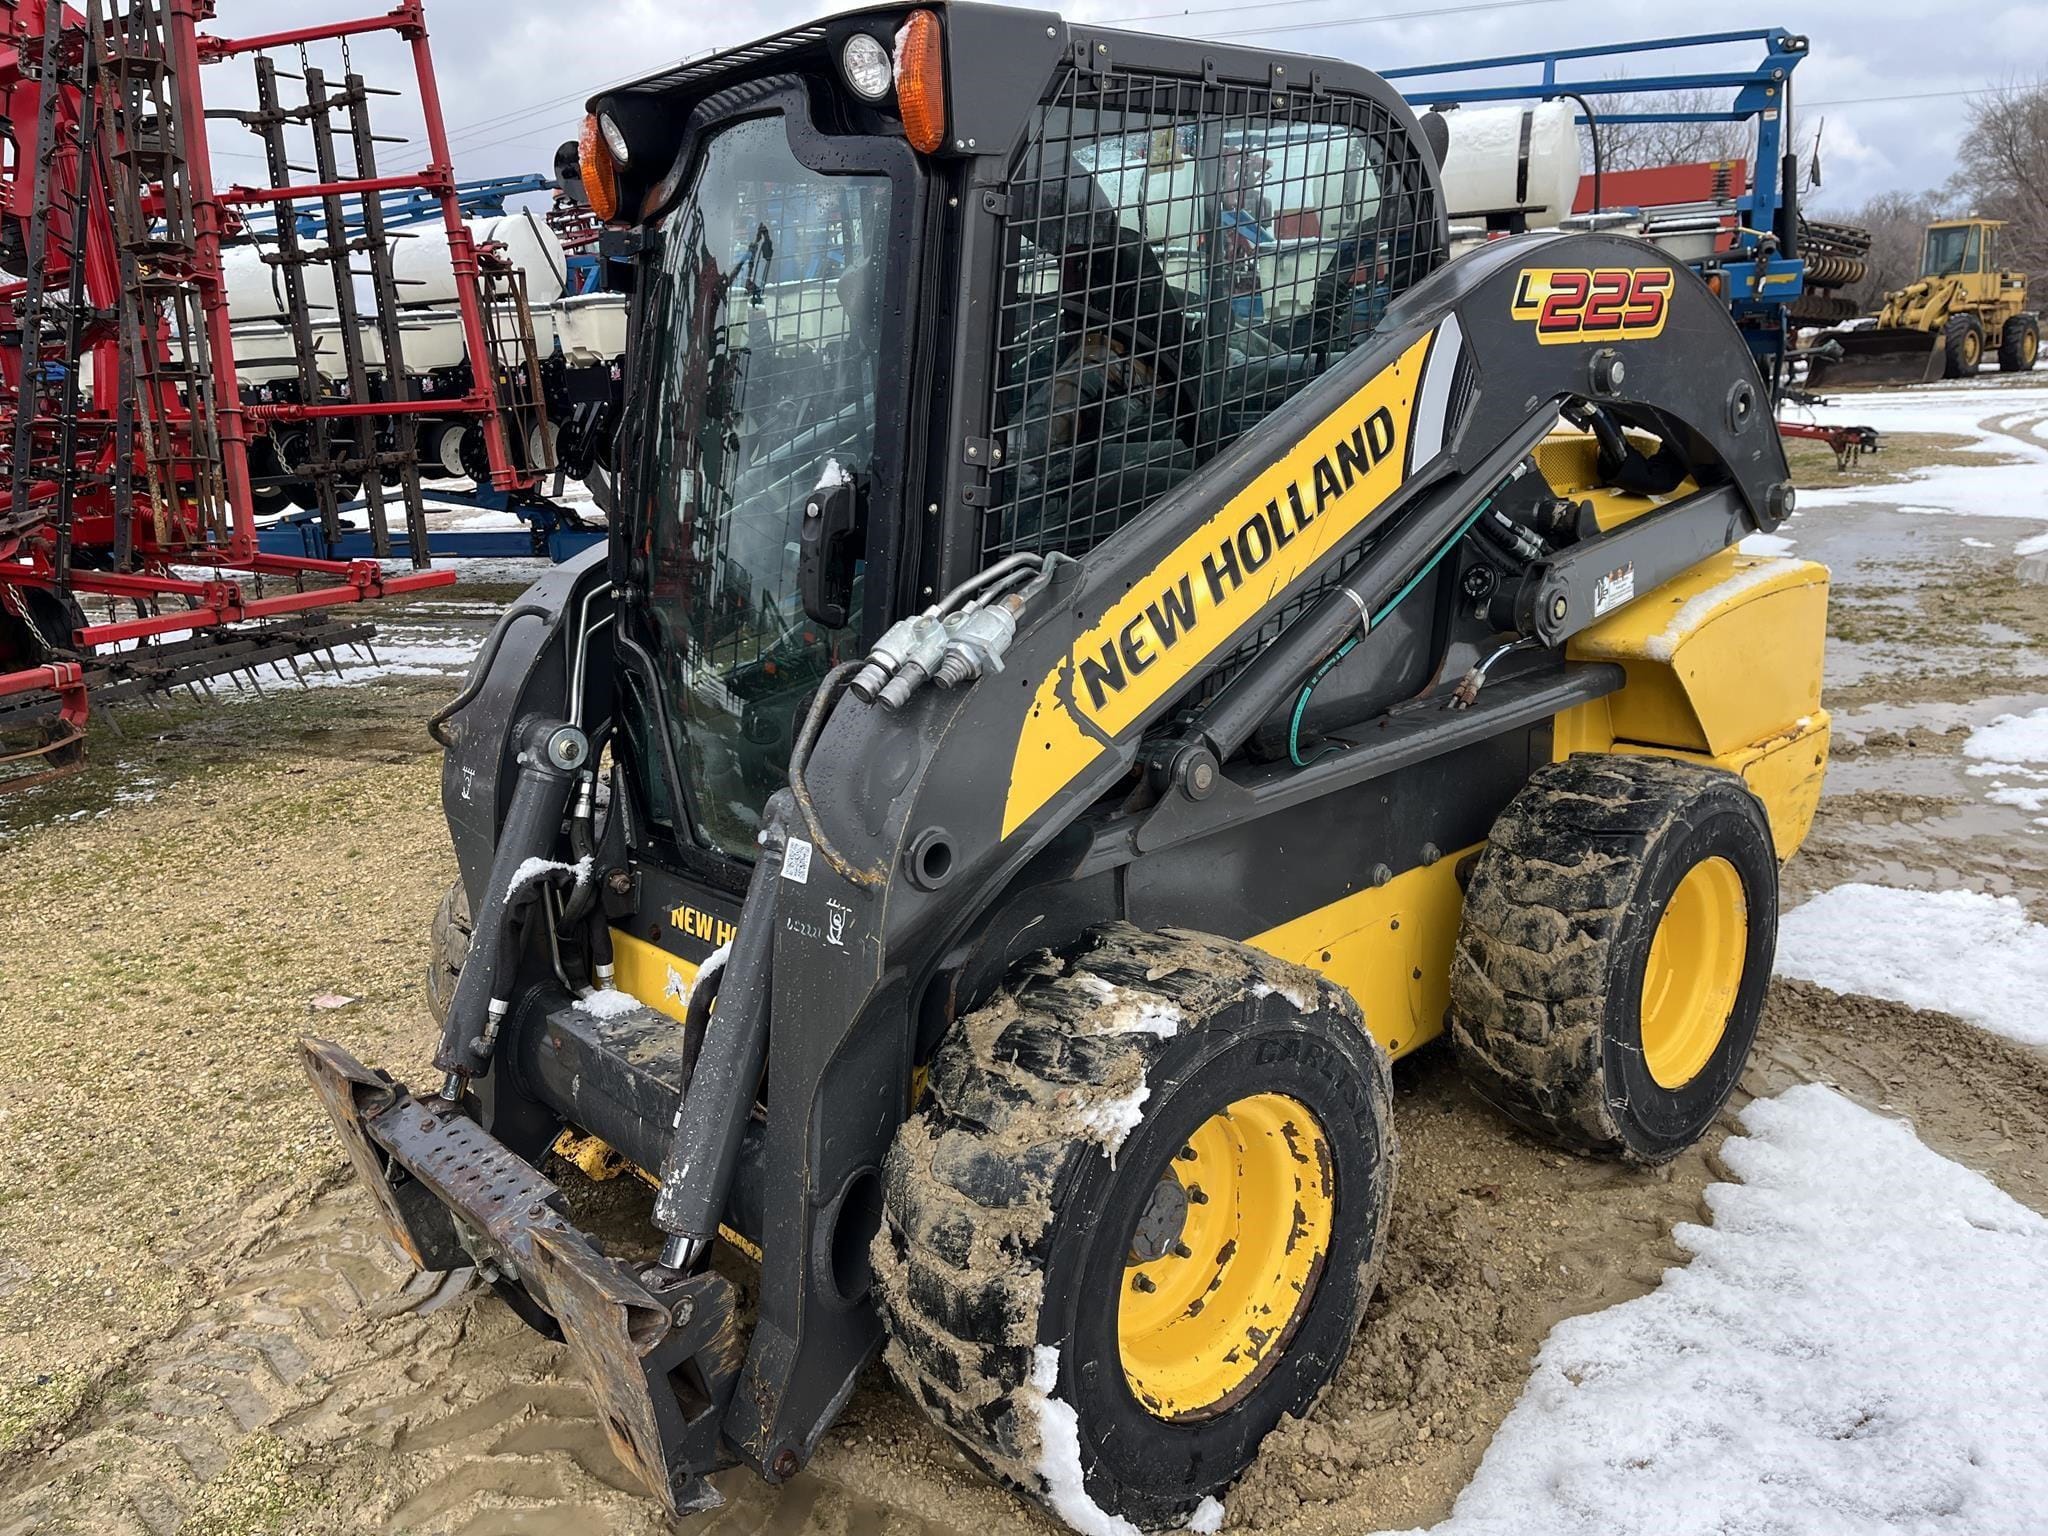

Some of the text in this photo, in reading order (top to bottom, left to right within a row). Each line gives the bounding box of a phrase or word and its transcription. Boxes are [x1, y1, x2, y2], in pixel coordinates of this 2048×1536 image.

[1514, 272, 1671, 333] L225
[1080, 404, 1396, 712] NEW HOLLAND
[671, 905, 713, 943] NEW
